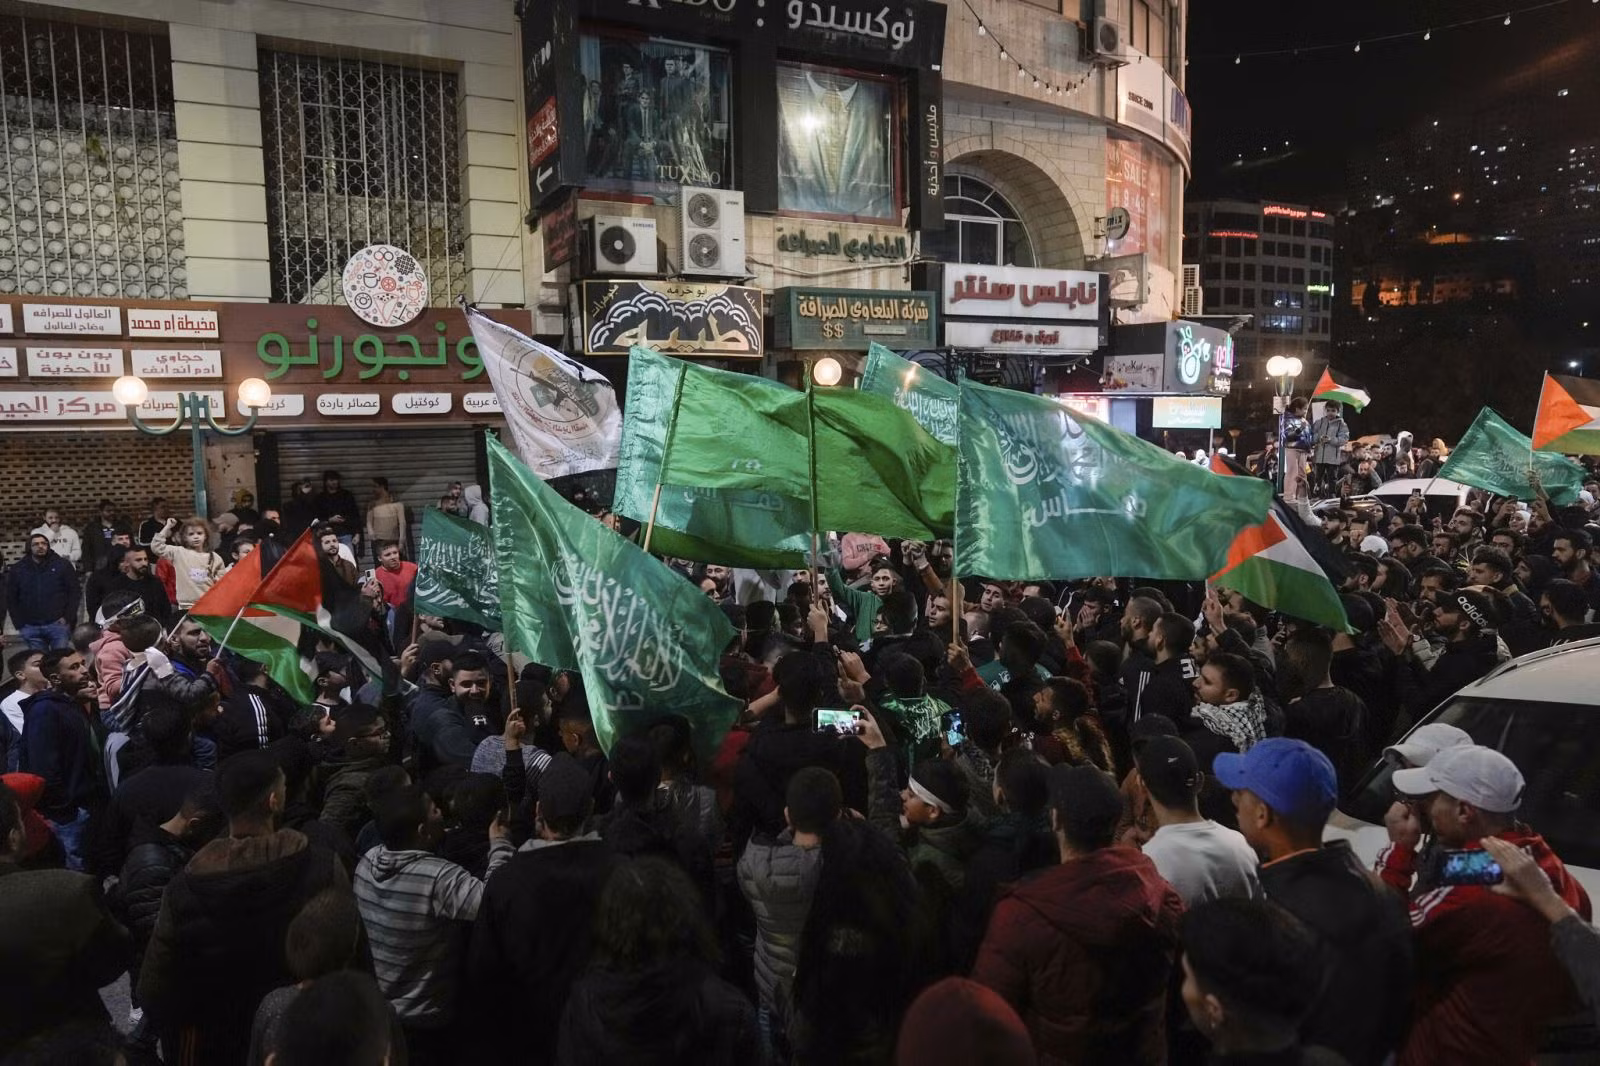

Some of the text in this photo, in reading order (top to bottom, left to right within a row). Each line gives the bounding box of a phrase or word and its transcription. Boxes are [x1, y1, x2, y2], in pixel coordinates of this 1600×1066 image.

[1124, 159, 1147, 189] SALE
[949, 275, 1097, 310] نابلس سنتر
[798, 295, 929, 323] شركة البلعاوي للصرافة
[131, 319, 161, 330] محمد
[156, 352, 203, 364] حجاوي
[257, 318, 485, 380] ونجورنو
[57, 397, 116, 416] مركز
[319, 398, 378, 410] عصائر باردة
[405, 396, 440, 409] كوكتيل
[465, 397, 490, 408] عربية
[1457, 596, 1488, 627] adidas
